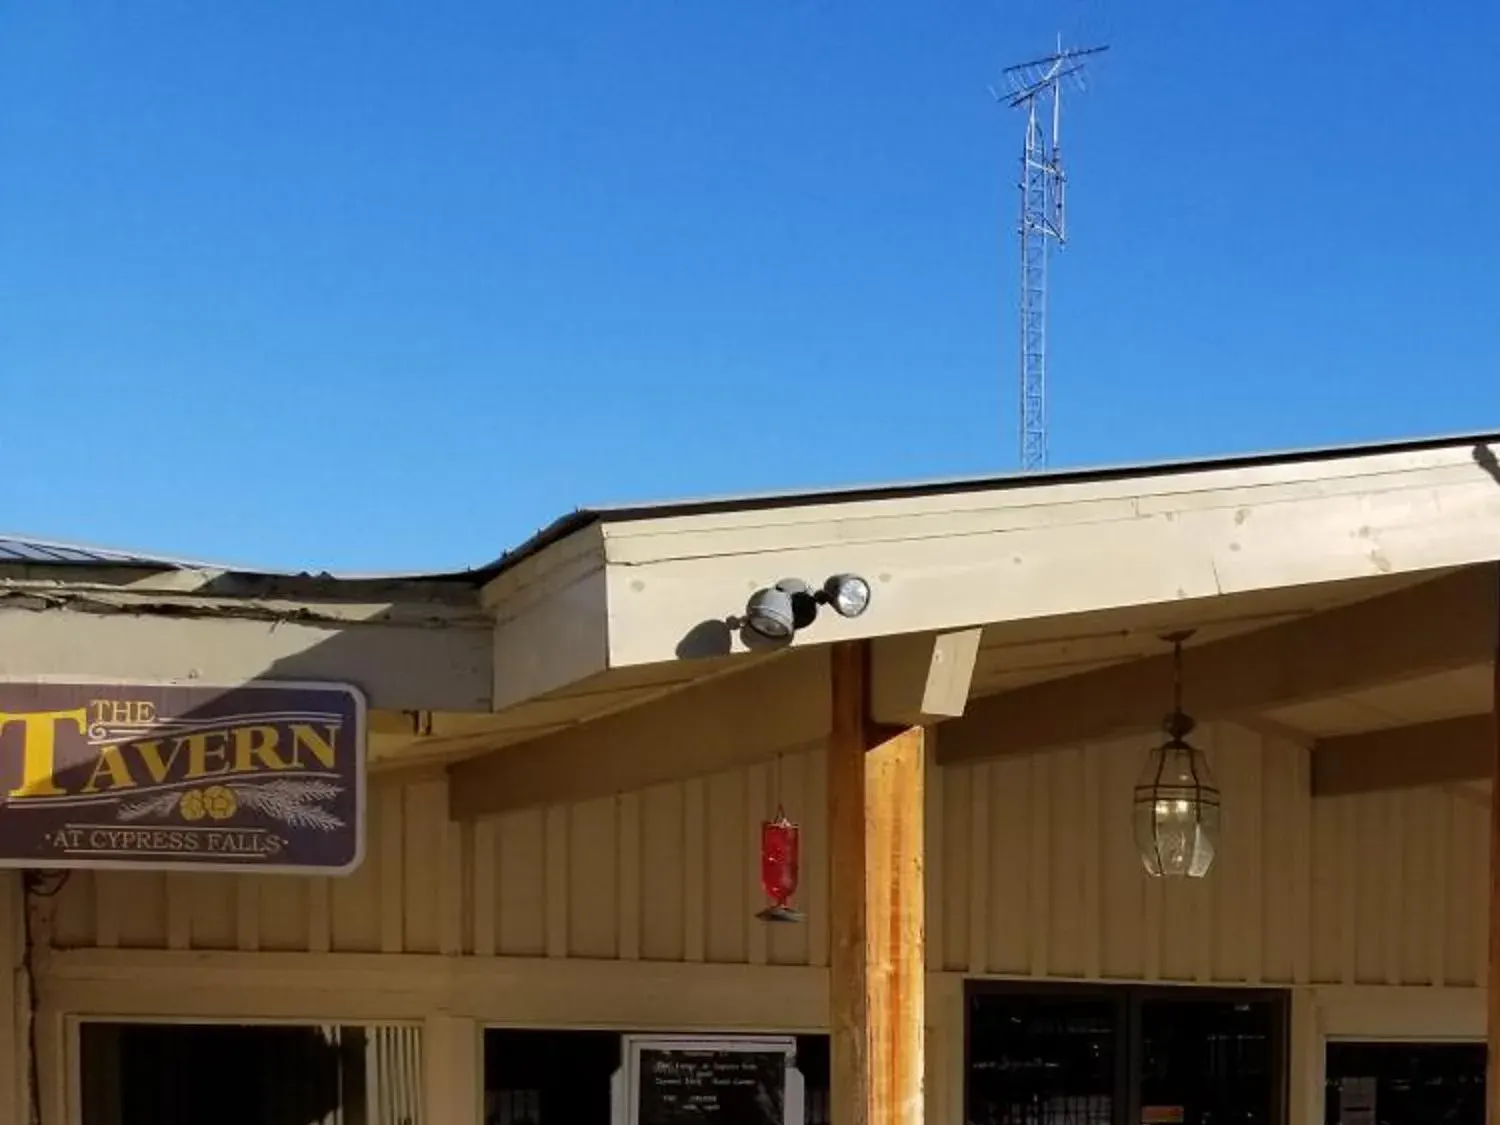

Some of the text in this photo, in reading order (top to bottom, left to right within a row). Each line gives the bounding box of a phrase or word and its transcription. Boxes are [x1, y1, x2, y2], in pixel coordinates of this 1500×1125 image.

[90, 699, 156, 723] THE
[0, 707, 341, 797] TAVERN
[53, 830, 283, 852] AT CYPRESS FALLS
